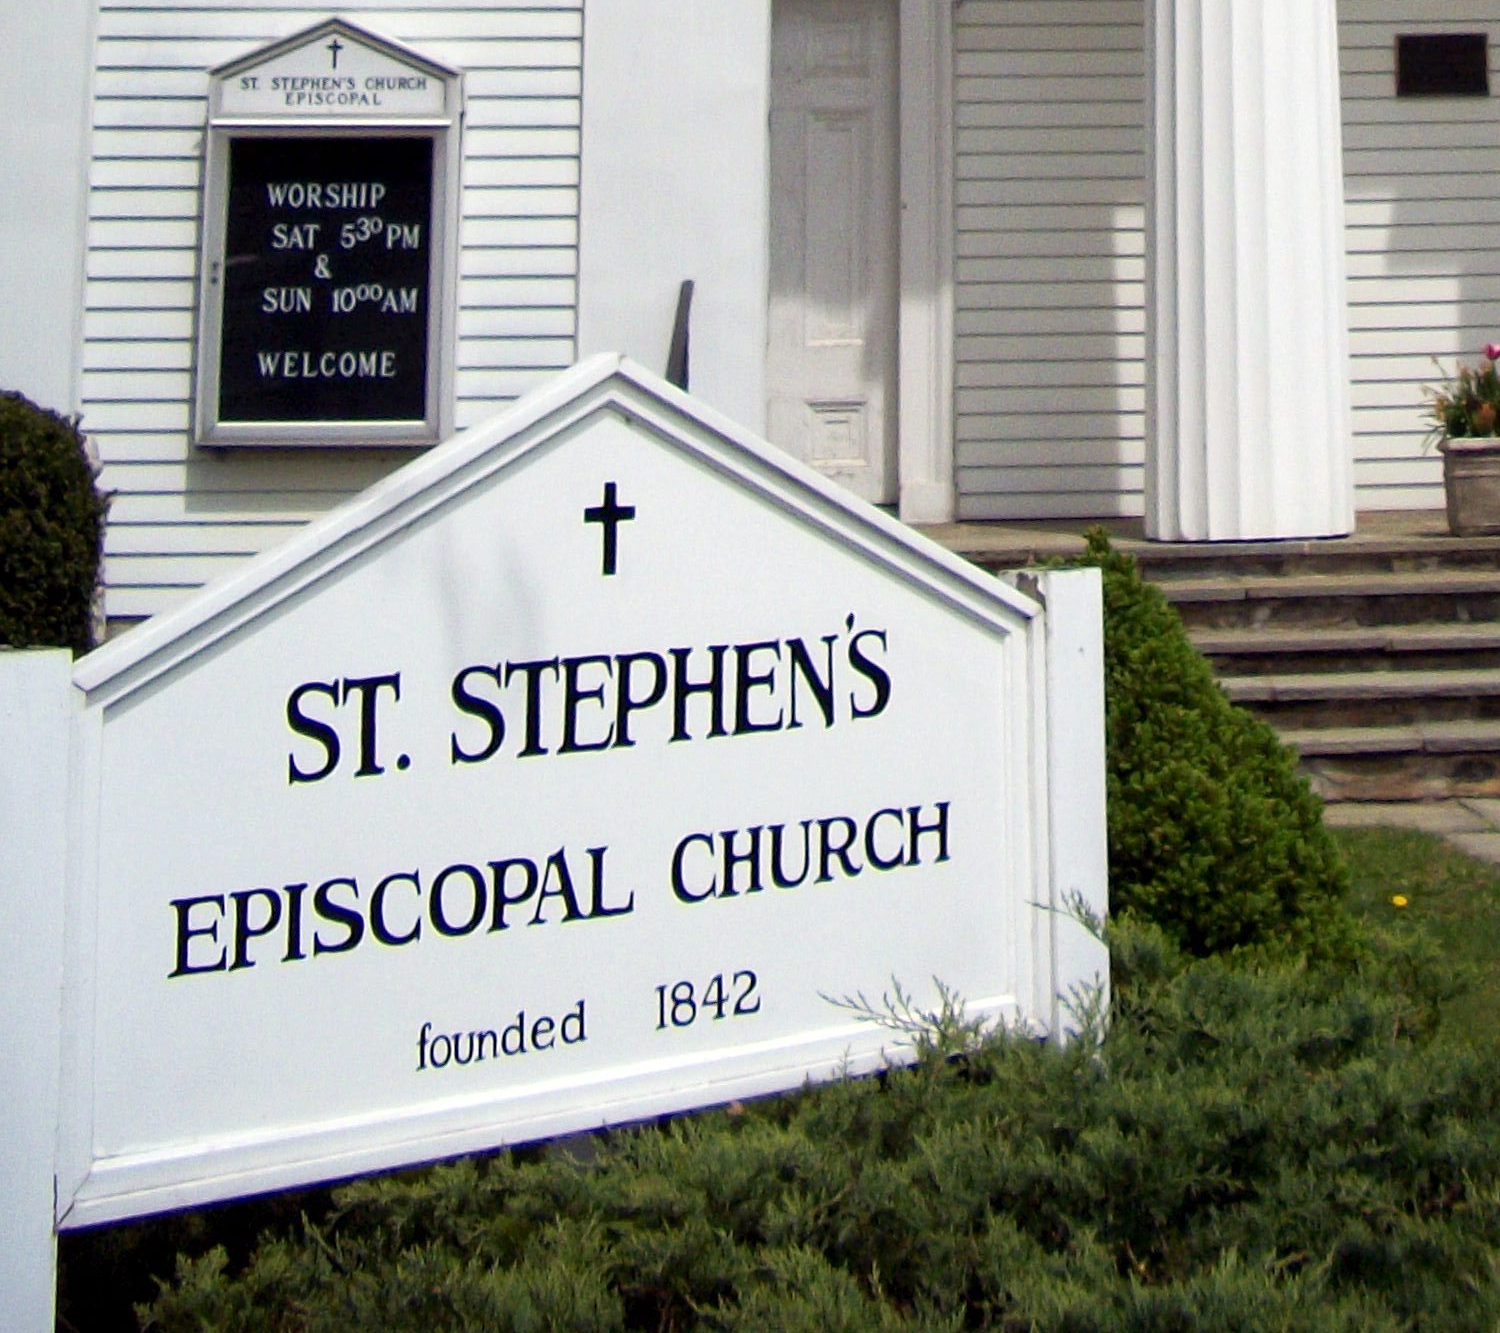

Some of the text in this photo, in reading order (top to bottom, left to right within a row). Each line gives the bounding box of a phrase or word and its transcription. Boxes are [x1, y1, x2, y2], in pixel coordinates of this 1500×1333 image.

[271, 77, 356, 91] STEPHEN'S
[364, 77, 428, 90] CHURCH
[284, 93, 382, 106] EPISCOPAL
[266, 183, 386, 208] WORSHIP
[272, 223, 320, 249] SAT
[314, 255, 332, 279] &
[262, 287, 312, 312] SUN
[257, 352, 396, 377] WELCOME
[286, 613, 892, 785] ST. STEPHEN'S
[167, 801, 951, 979] EPISCOPAL CHURCH
[415, 969, 762, 1071] founded 1842
